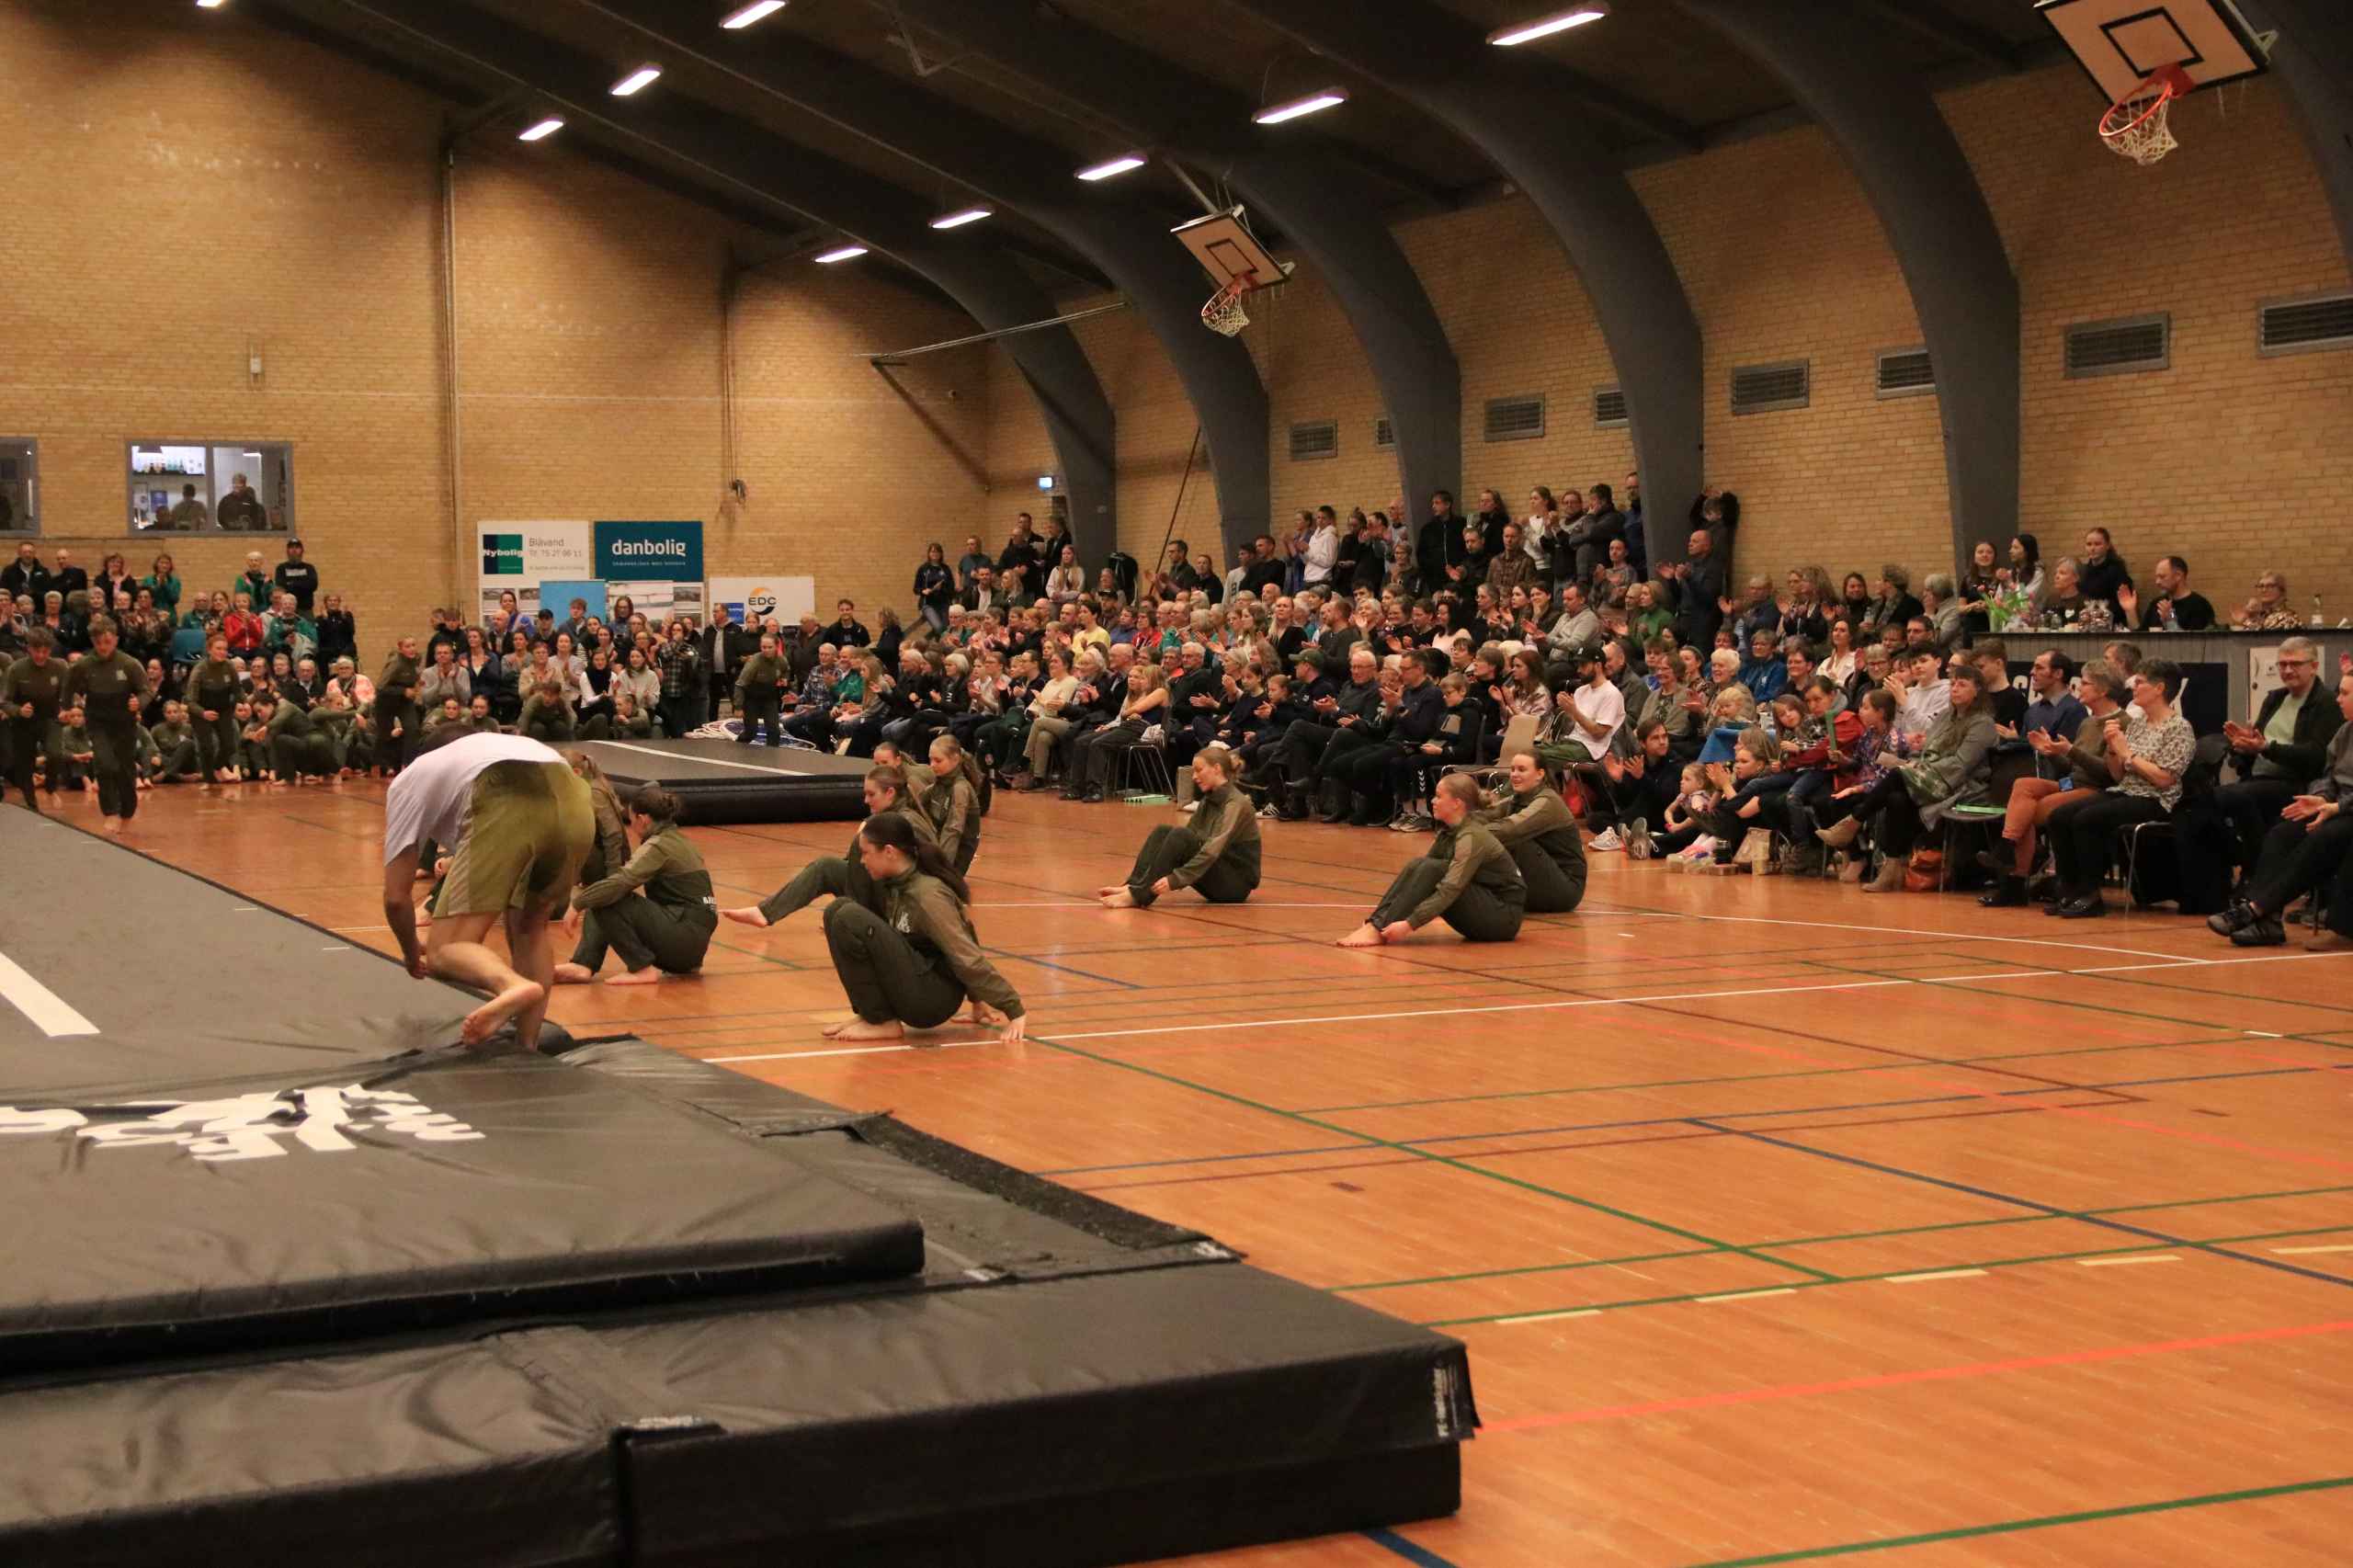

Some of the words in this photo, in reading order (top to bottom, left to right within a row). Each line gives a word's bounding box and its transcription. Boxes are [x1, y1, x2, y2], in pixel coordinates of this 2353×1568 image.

[611, 539, 687, 557] danbolig
[483, 549, 523, 558] Nybolig
[748, 597, 777, 606] EDC
